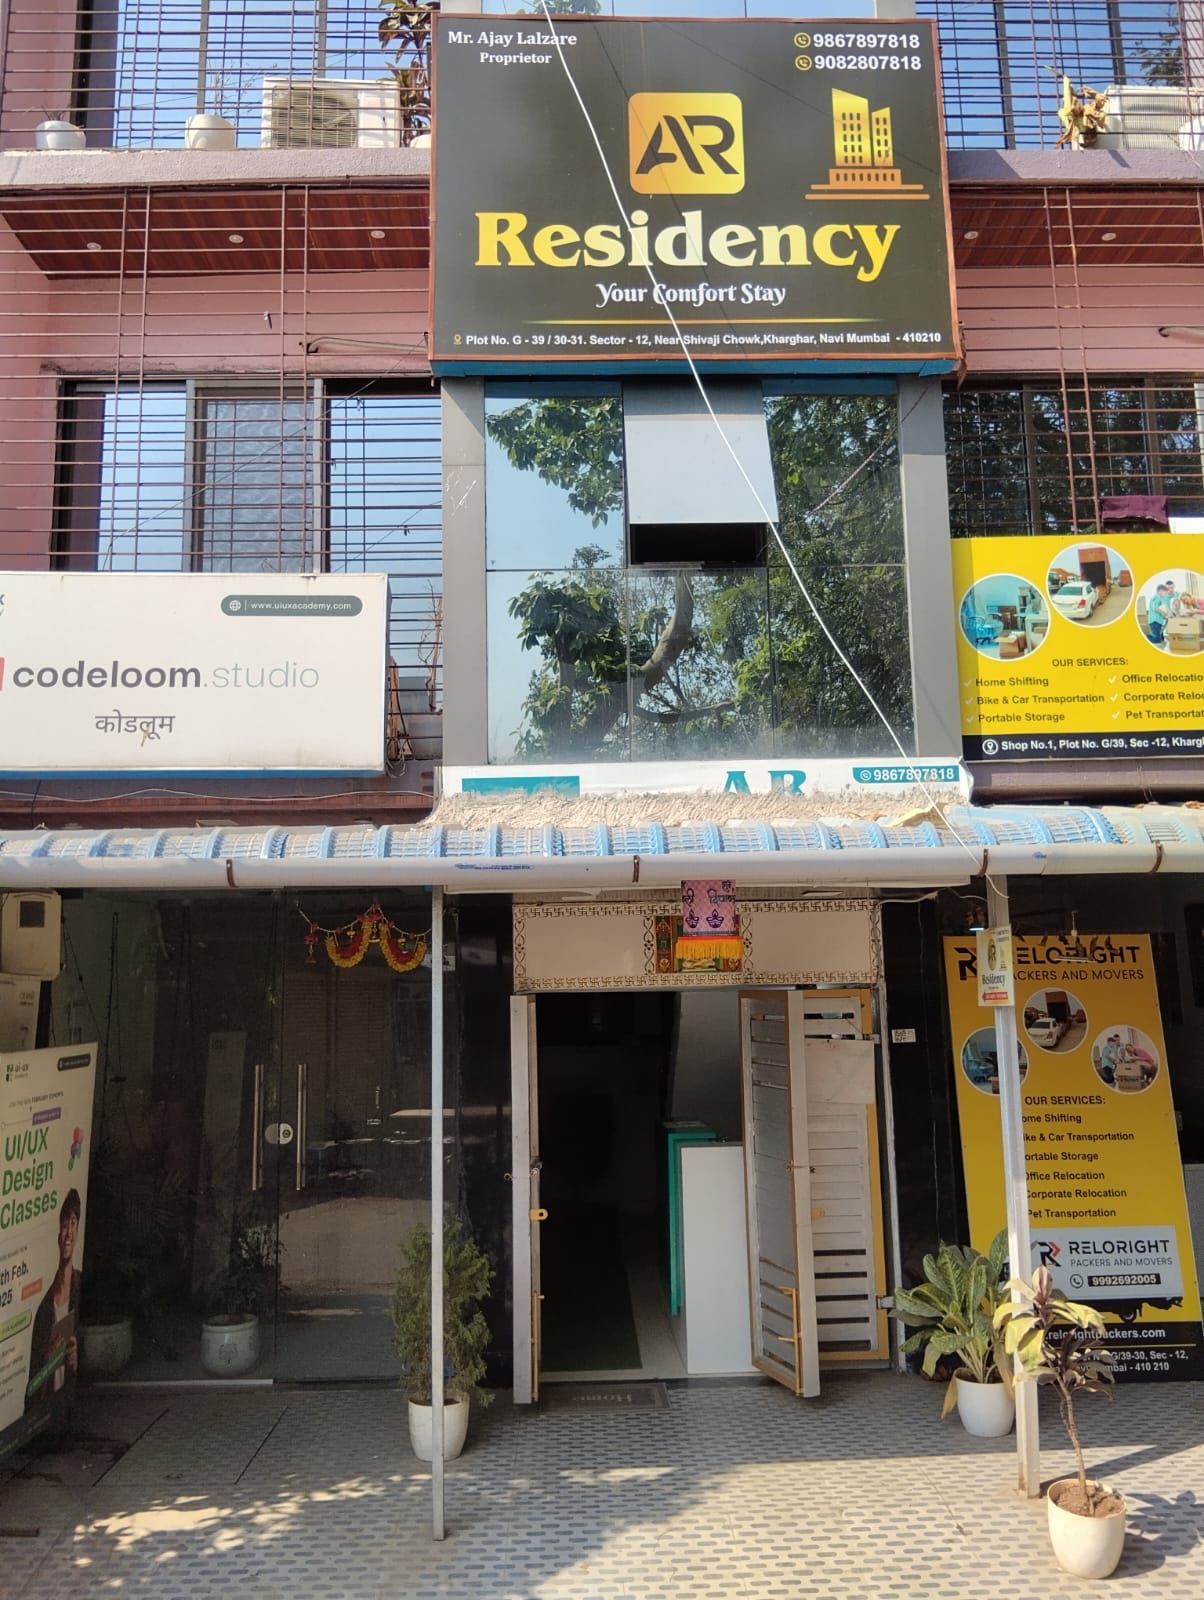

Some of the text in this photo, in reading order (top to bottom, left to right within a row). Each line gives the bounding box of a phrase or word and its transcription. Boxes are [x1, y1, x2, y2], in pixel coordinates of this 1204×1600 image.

[447, 31, 578, 48] Mr. Ajay Lalzare
[812, 33, 920, 49] 9867897818
[479, 51, 552, 65] Proprietor
[814, 54, 922, 70] 9082807818
[635, 115, 740, 175] AR
[474, 209, 902, 283] Residency
[595, 283, 787, 308] Your Comfort Stay
[466, 335, 489, 345] Plot
[490, 335, 510, 345] No.
[512, 335, 523, 345] G
[531, 335, 545, 345] 39
[589, 334, 627, 345] Sector
[636, 334, 652, 346] 12,
[654, 334, 681, 344] Near
[684, 333, 721, 347] Shivaji
[820, 333, 844, 344] Navi
[847, 332, 890, 344] Mumbai
[902, 332, 942, 343] 410210
[1052, 657, 1129, 668] OUR SERVICES:
[13, 660, 320, 689] codeloom.studio
[1121, 673, 1204, 683] Office Relocatio
[975, 676, 1049, 687] Home Shifting
[976, 693, 1105, 705] Bike & Car Transportation
[1123, 691, 1204, 702] Corporate Reloc
[978, 712, 1065, 723] Portable Storage
[1125, 708, 1204, 719] Pet Transportat
[94, 708, 176, 740] कोडलूम
[1001, 740, 1028, 752] Shop
[1059, 739, 1080, 749] Plot
[1082, 738, 1100, 749] No.
[1101, 738, 1128, 750] G/39,
[1130, 738, 1149, 748] Sec
[872, 767, 955, 783] 9867897818
[1016, 946, 1140, 965] ELOIGHT
[1014, 969, 1144, 981] CKERS AND MOVERS
[1025, 1095, 1106, 1105] OUR SERVICES:
[1021, 1113, 1082, 1124] ome Shifting
[1023, 1132, 1135, 1143] ike & Car Transportation
[4, 1126, 50, 1162] UI/UX
[1024, 1152, 1099, 1162] ortable Storage
[2, 1158, 54, 1196] Design
[1053, 1171, 1105, 1180] Relocation
[1075, 1188, 1127, 1198] Relocation
[0, 1190, 58, 1229] Classes
[1045, 1208, 1116, 1219] Transportation
[1068, 1239, 1170, 1255] RELORIGHT
[1070, 1257, 1173, 1267] PACKERS AND MOVERS
[0, 1260, 29, 1287] th Feb.
[1092, 1274, 1157, 1286] 9992692005
[1150, 1350, 1167, 1360] Sec
[1135, 1363, 1151, 1372] 410
[1154, 1362, 1170, 1371] 210
